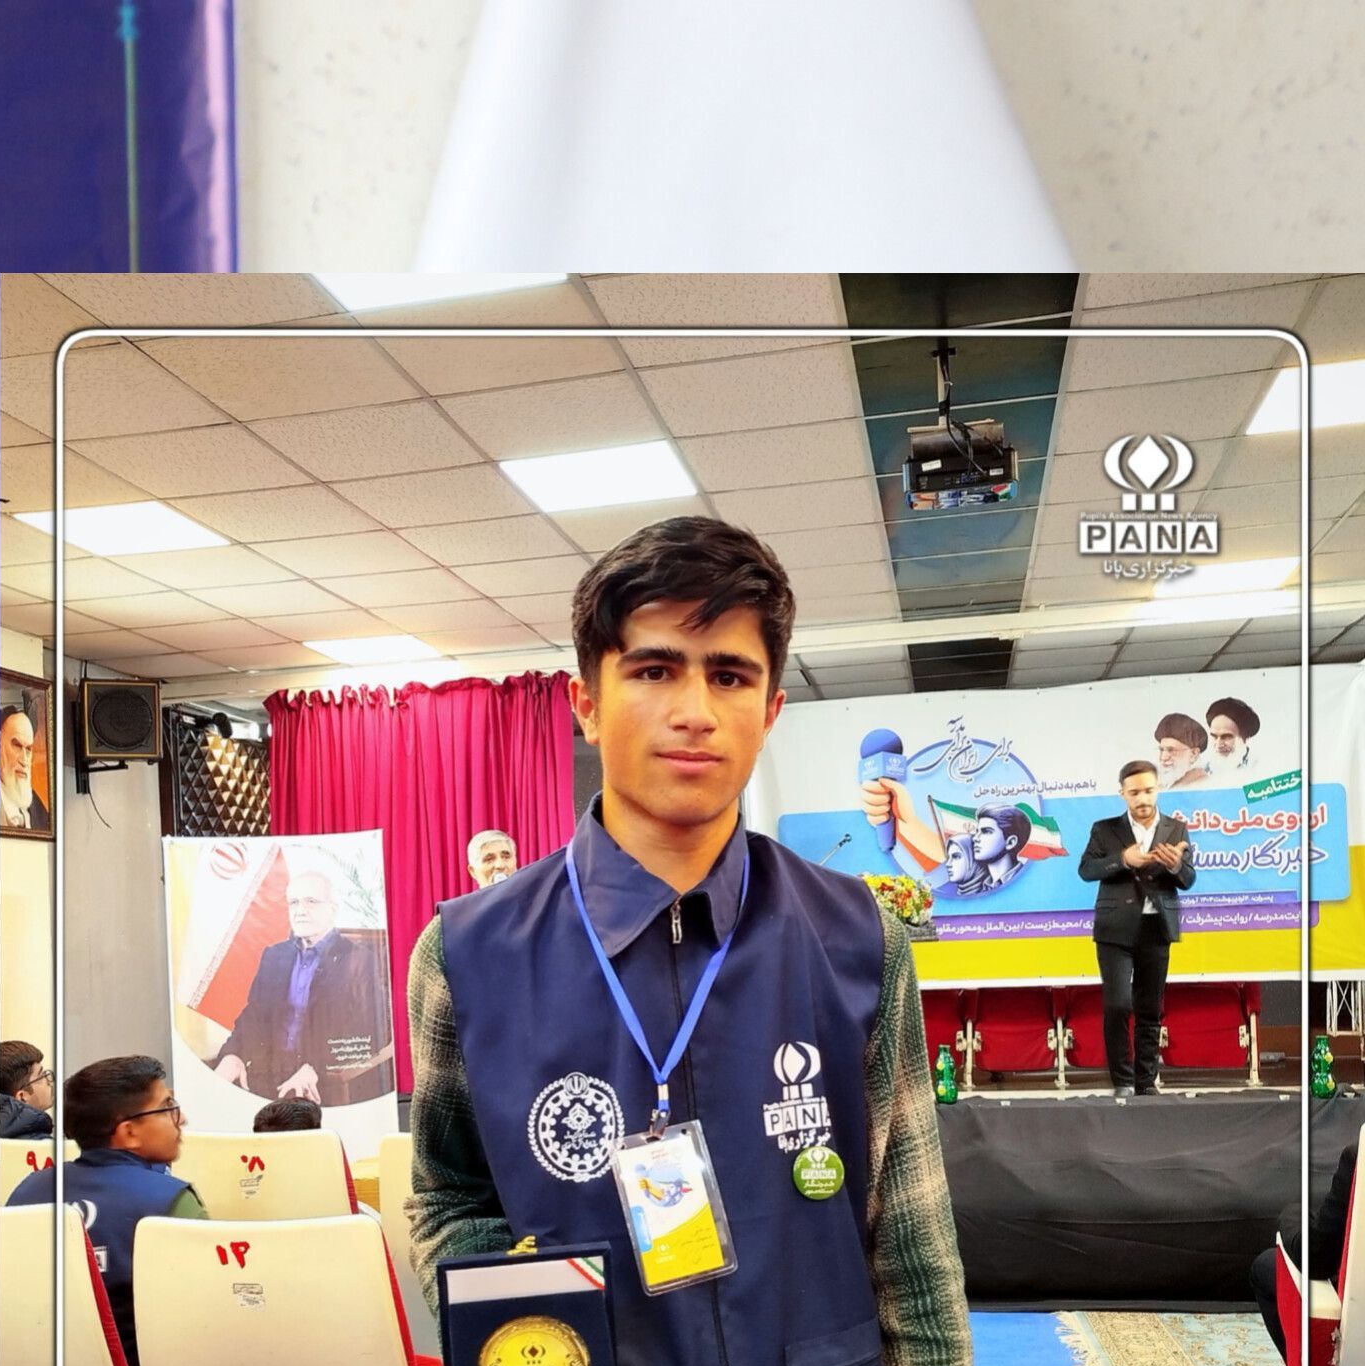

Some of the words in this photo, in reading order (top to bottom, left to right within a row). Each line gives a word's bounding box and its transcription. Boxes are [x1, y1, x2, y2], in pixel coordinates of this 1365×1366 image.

[1001, 783, 1036, 796] بهترین
[1036, 781, 1063, 793] دنبال
[1247, 772, 1302, 800] ختتامیه
[1223, 808, 1265, 834] ملی
